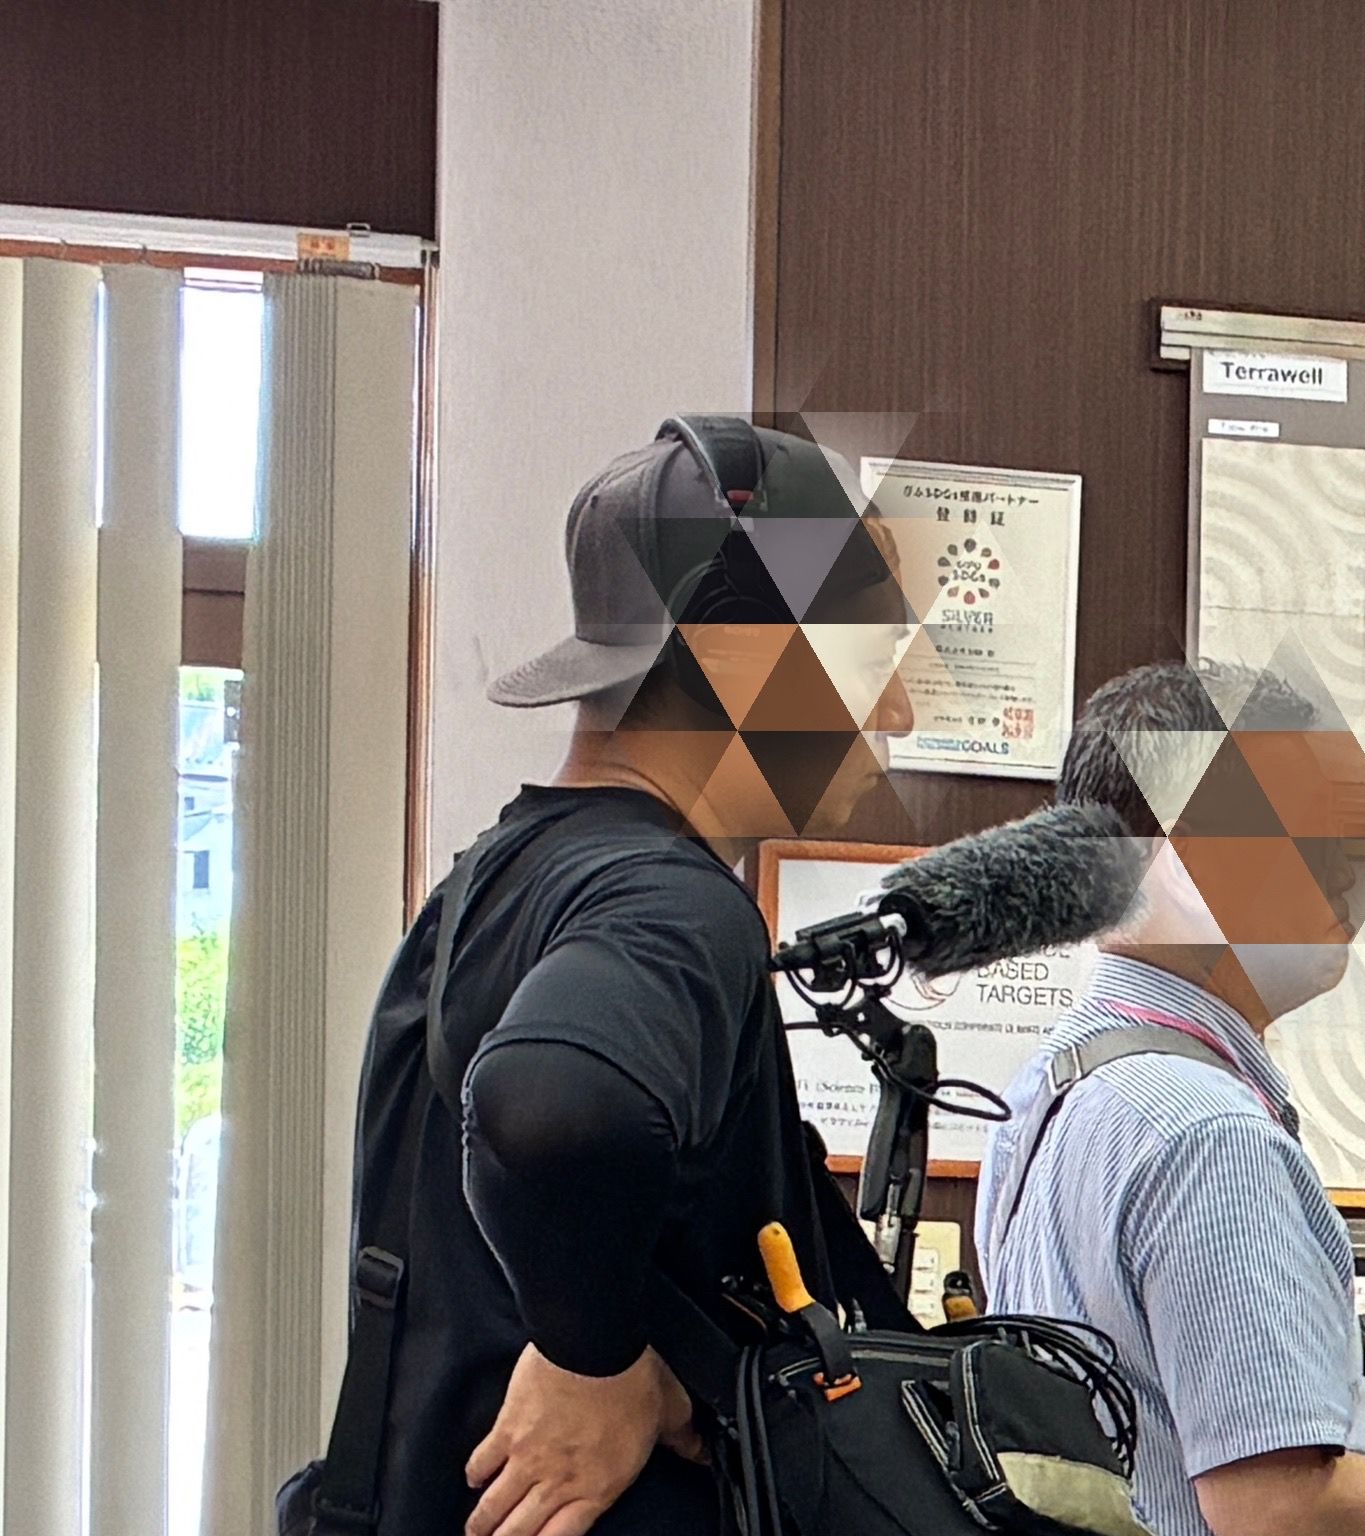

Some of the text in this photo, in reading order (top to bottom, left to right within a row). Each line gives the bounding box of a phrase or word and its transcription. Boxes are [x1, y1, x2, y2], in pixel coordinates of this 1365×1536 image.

[1221, 361, 1323, 385] Terrawell
[941, 609, 993, 626] SILVER
[976, 984, 1074, 1007] TARGETS
